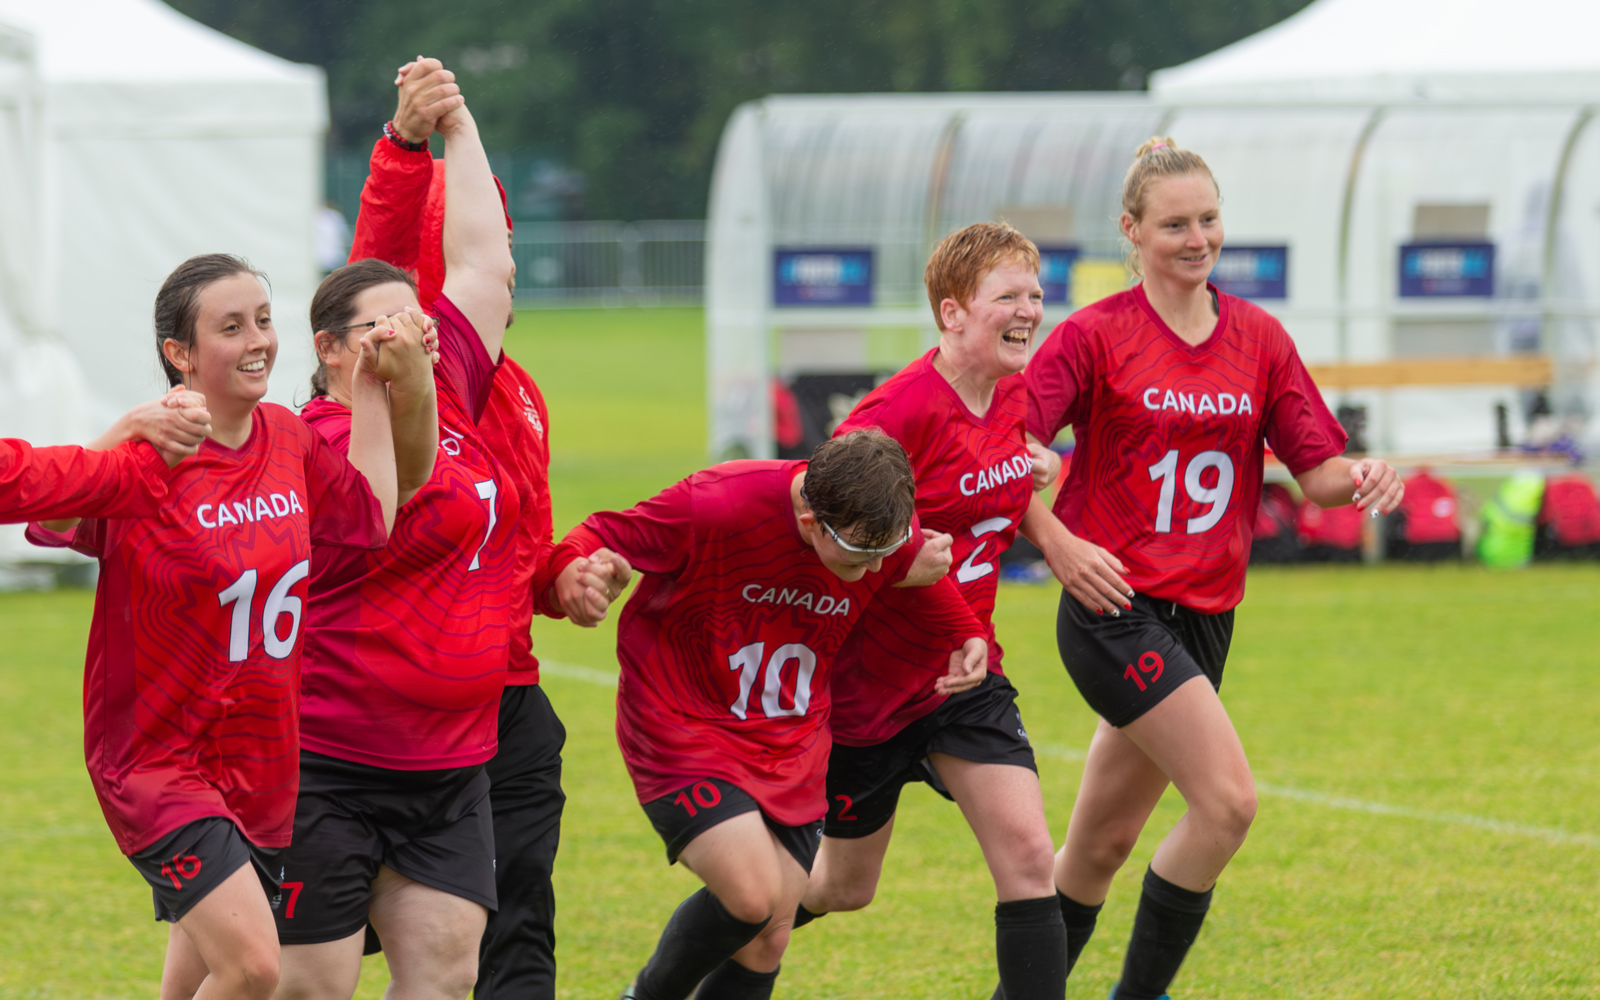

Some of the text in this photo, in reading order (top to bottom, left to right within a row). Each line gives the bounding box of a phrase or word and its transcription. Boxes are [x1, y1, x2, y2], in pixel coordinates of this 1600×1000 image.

[1143, 387, 1252, 416] CANADA
[959, 452, 1034, 497] CANADA
[1147, 449, 1235, 534] 19
[196, 489, 304, 529] CANADA
[468, 478, 498, 572] 7
[956, 516, 1013, 584] 2
[217, 558, 310, 663] 16
[741, 583, 851, 617] CANADA
[727, 640, 818, 721] 10
[1123, 650, 1165, 692] 19
[673, 780, 722, 818] 10
[834, 794, 858, 821] 2
[161, 849, 202, 891] 16
[280, 881, 304, 919] 7
